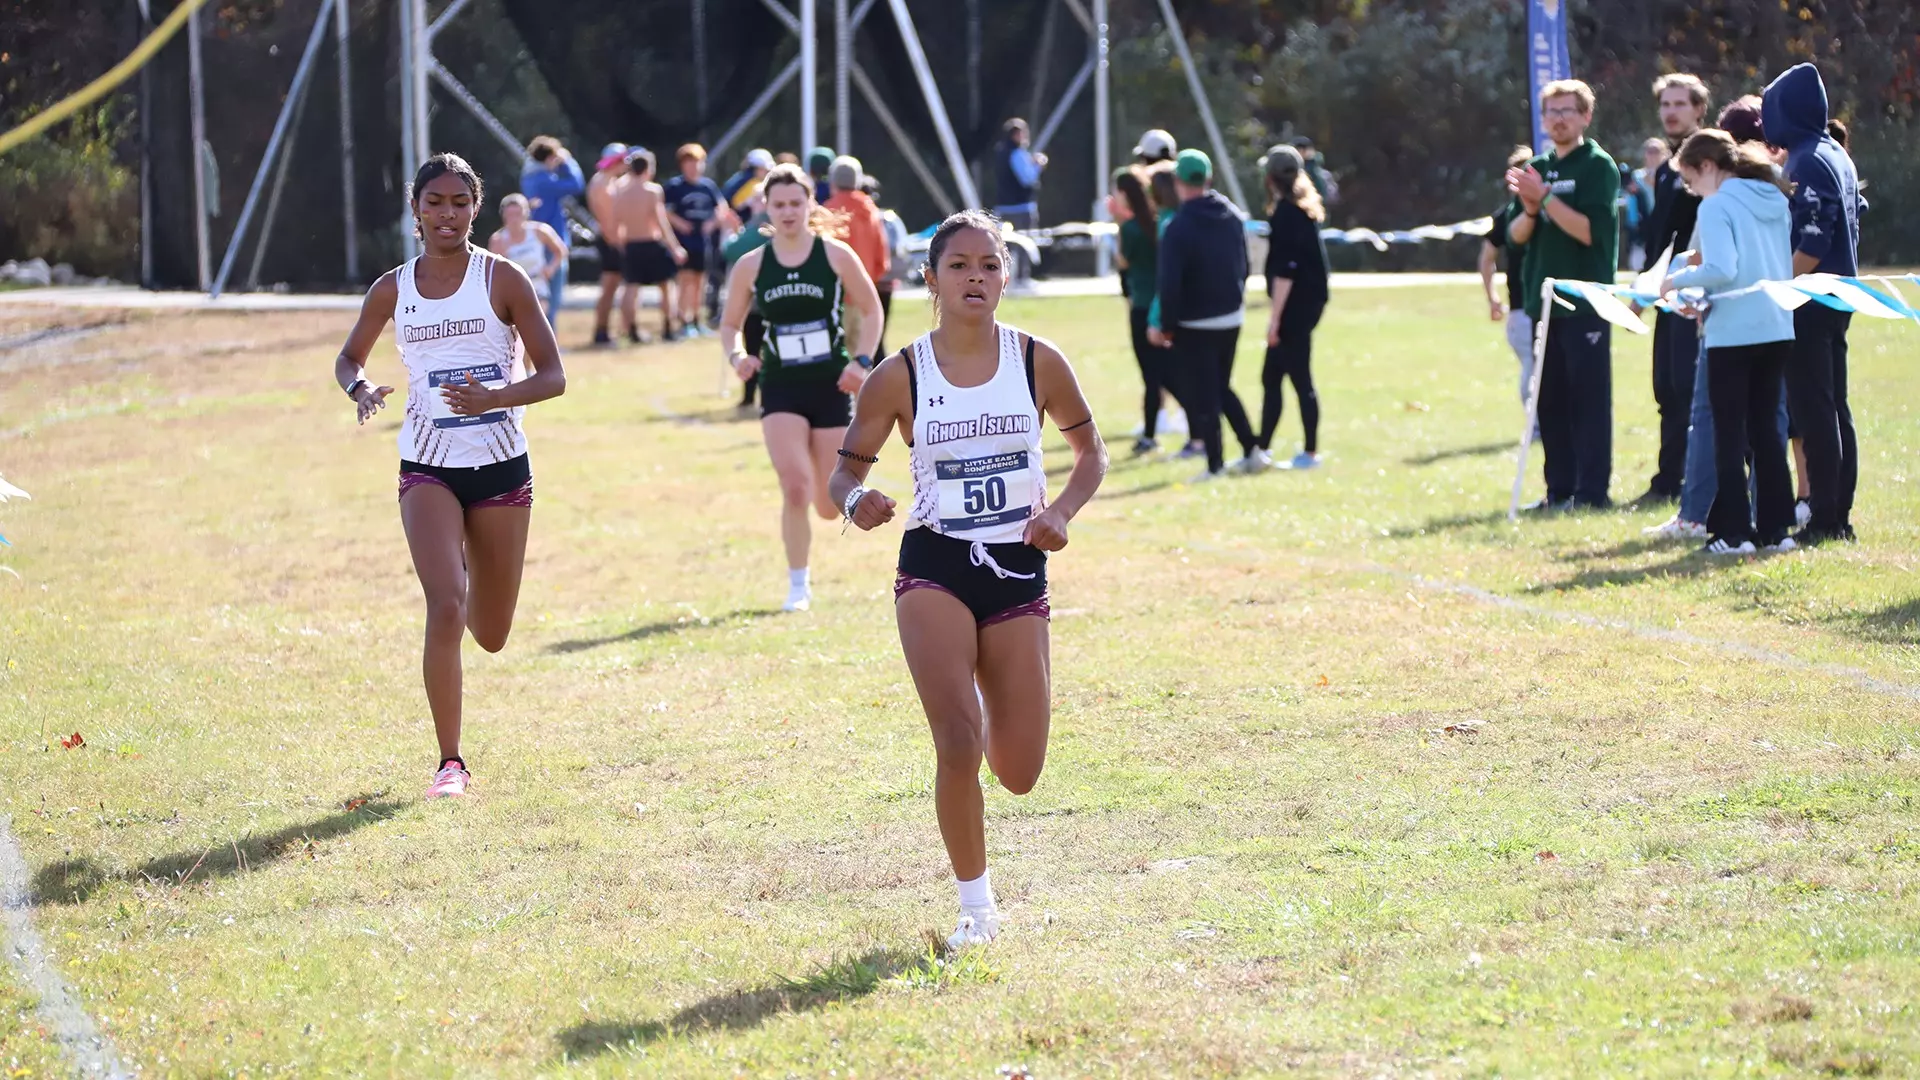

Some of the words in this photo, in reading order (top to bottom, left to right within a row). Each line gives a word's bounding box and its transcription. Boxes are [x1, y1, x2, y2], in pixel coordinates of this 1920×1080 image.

[764, 282, 824, 303] CASTLETON
[404, 325, 440, 343] RHODE
[441, 318, 486, 337] ISLAND
[797, 336, 807, 355] 1
[450, 371, 495, 381] CONRENCE
[927, 420, 977, 445] RHODE
[979, 413, 1031, 436] ISLAND
[964, 458, 993, 467] LITTLE
[995, 454, 1017, 463] EAST
[964, 459, 1019, 473] CONFERENCE
[963, 476, 1007, 515] 50
